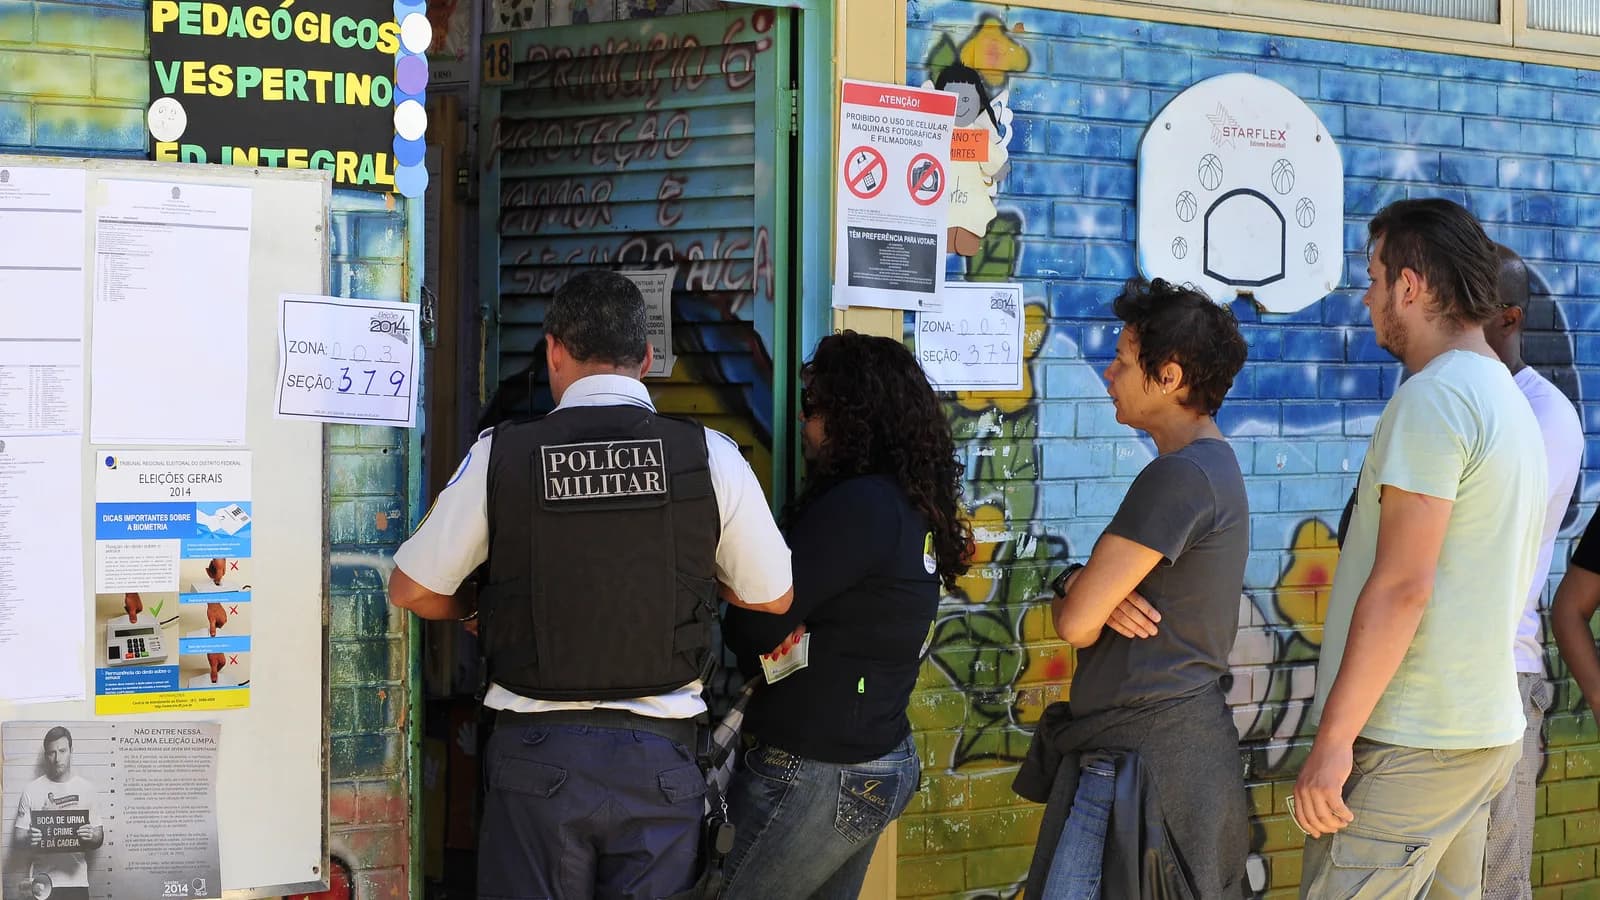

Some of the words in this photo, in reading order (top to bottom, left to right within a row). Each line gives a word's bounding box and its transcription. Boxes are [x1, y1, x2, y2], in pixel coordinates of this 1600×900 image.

[152, 0, 401, 54] PEDAGÓGICOS
[487, 43, 510, 77] 18
[155, 61, 393, 107] VESPERTINO
[880, 95, 920, 108] ATENÇÃO!
[846, 112, 880, 123] PROIBIDO
[890, 117, 904, 126] USO
[906, 119, 914, 127] DE
[916, 121, 949, 133] CELULAR,
[486, 99, 695, 171] PROTEÇÃO
[852, 122, 890, 133] MÁQUINAS
[892, 127, 942, 141] FOTOGRÁFICAS
[1223, 127, 1286, 141] STARFLEX
[878, 135, 922, 147] FILMADORAS!
[221, 146, 395, 185] INTEGRAL
[950, 176, 968, 204] rtes
[500, 175, 614, 232] AMOR
[849, 230, 860, 239] TÊM
[862, 231, 904, 243] PREFERÊNCIA
[904, 236, 917, 244] PARA
[991, 295, 1016, 309] 2014
[370, 316, 410, 334] 2014
[922, 321, 955, 332] ZONA:
[288, 340, 328, 355] ZONA:
[923, 348, 960, 364] SEÇÃO:
[287, 373, 334, 392] SEÇÃO:
[338, 366, 405, 396] 379
[549, 443, 660, 473] POLÍCIA
[139, 472, 184, 485] ELEIÇÕES
[188, 474, 223, 483] GERAIS
[550, 472, 662, 498] MILITAR
[170, 487, 191, 497] 2014
[103, 514, 123, 522] DICAS
[124, 514, 168, 522] IMPORTANTES
[133, 523, 168, 531] BIOMETRIA
[159, 737, 191, 745] ELEIÇÃO
[37, 816, 54, 824] BOCA
[56, 816, 64, 824] DE
[67, 816, 85, 824] URNA
[53, 828, 73, 836] CRIME
[165, 884, 188, 893] 2014
